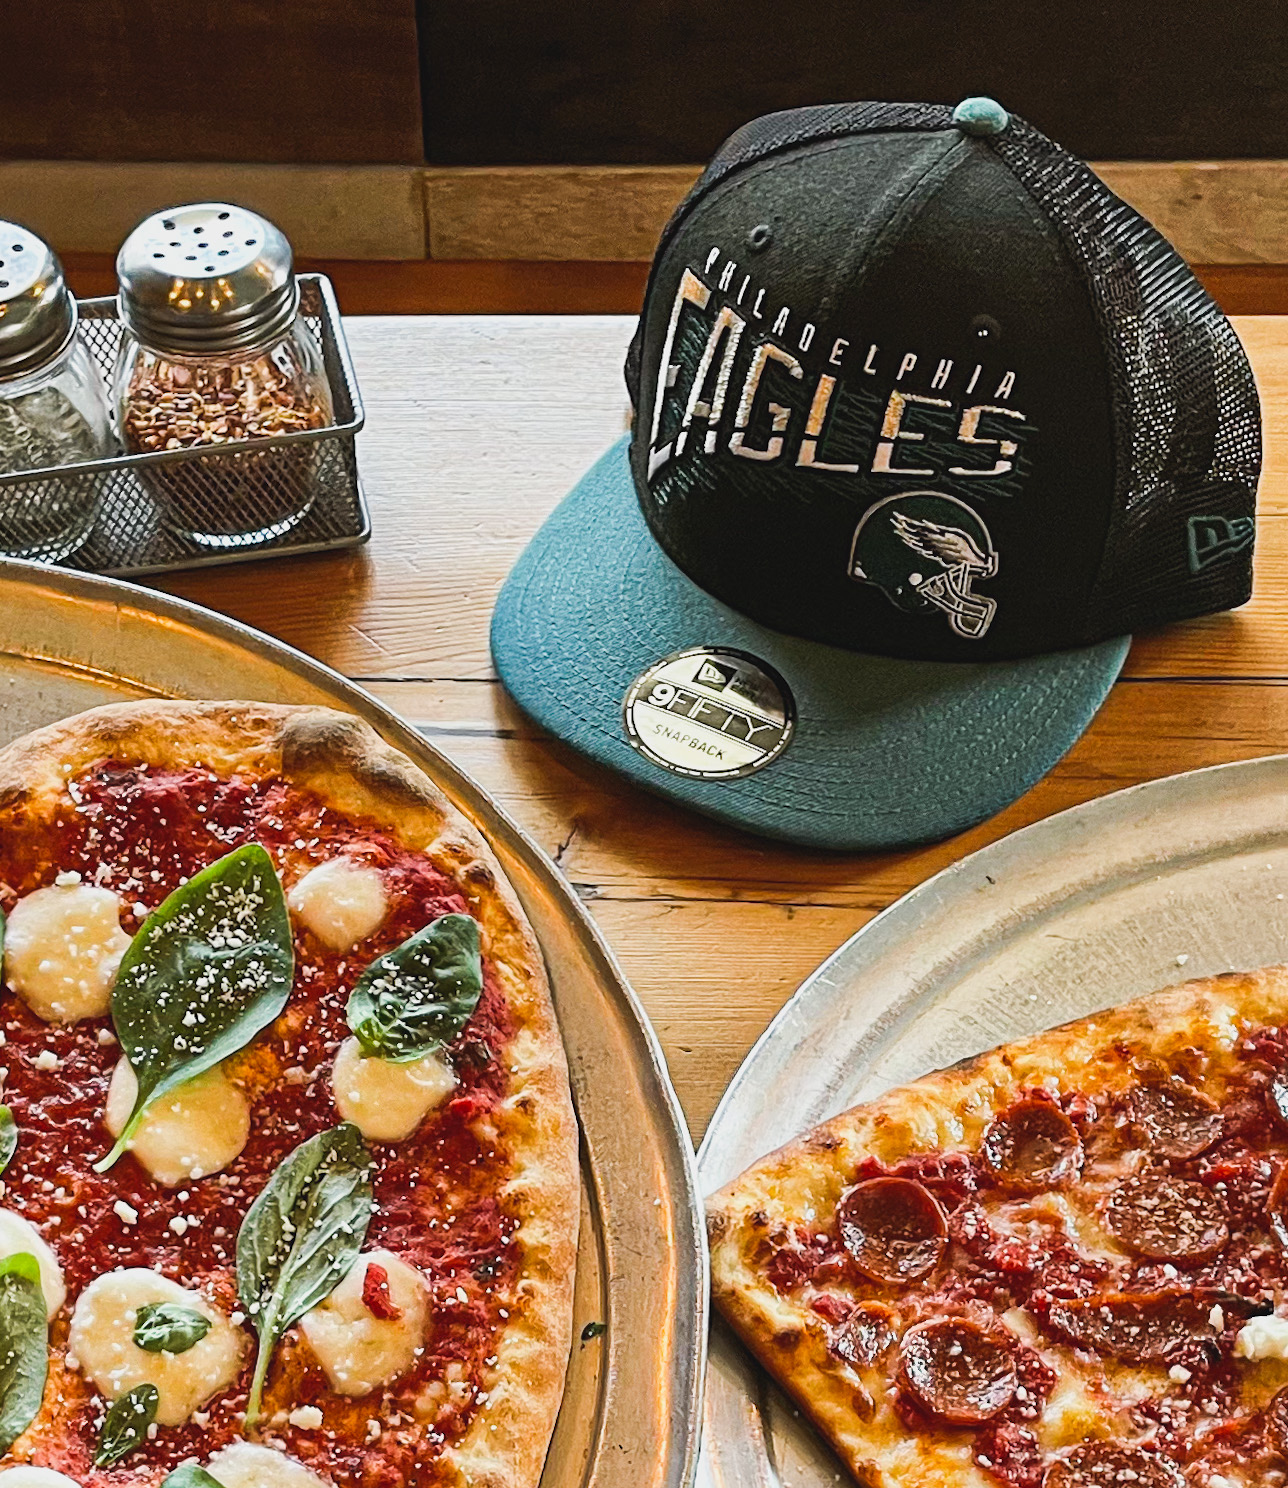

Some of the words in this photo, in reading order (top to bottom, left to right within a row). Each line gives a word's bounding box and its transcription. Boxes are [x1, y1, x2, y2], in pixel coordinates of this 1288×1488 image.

[647, 267, 1028, 484] EAGLES
[703, 246, 1016, 400] PHILADELPHIA
[646, 683, 775, 742] 9FIFTY
[652, 723, 728, 761] SNAPBACK
